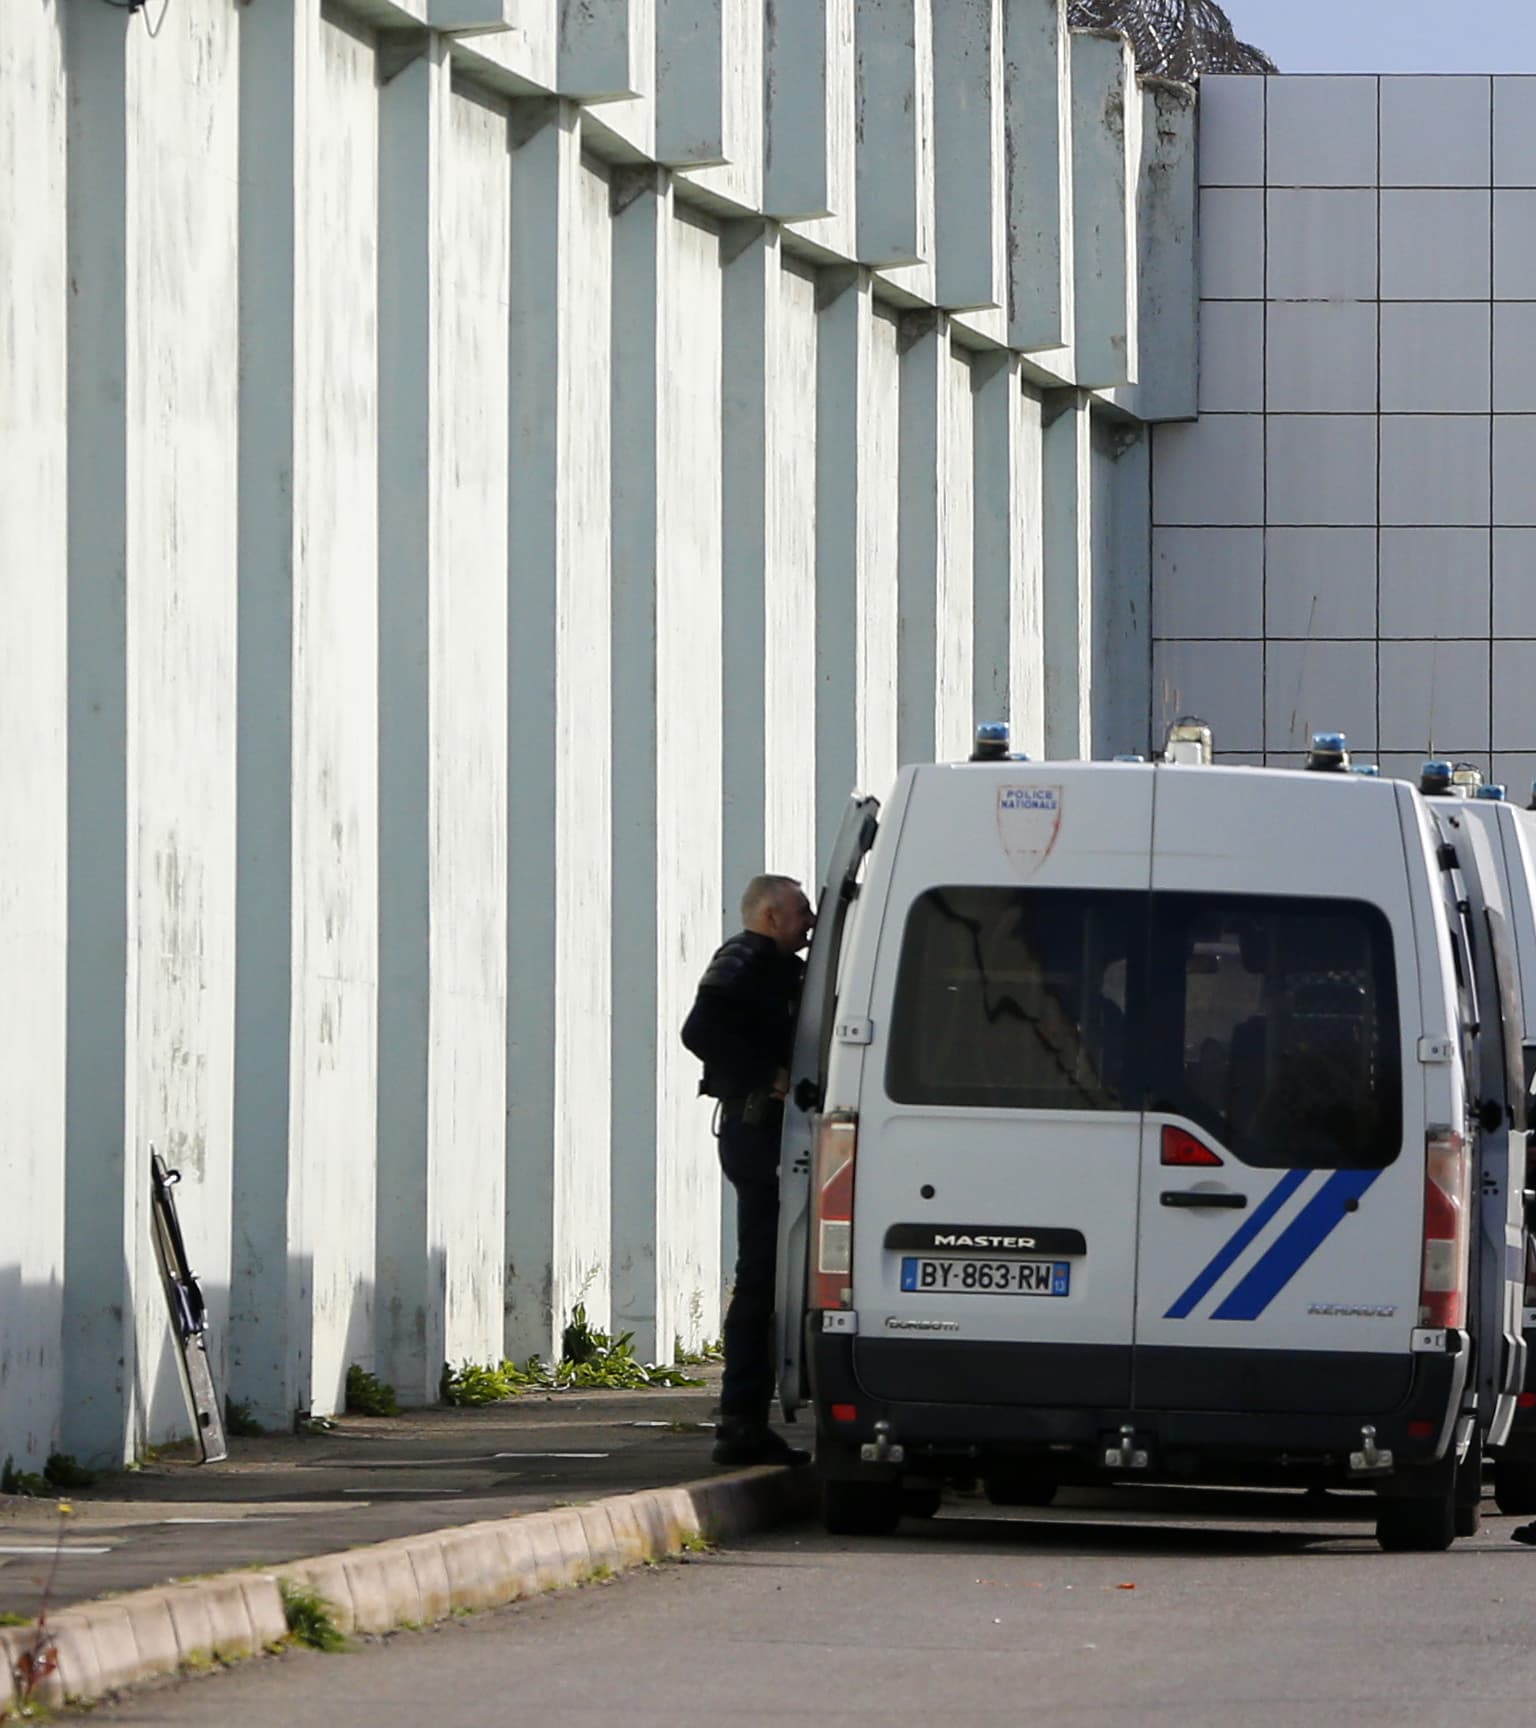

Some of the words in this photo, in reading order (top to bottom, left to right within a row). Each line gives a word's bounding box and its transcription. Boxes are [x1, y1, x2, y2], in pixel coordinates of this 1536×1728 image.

[1006, 790, 1054, 799] POLICE
[1000, 800, 1057, 809] NATIONALE
[934, 1234, 1037, 1249] MASTER
[920, 1262, 1051, 1290] BY-863-RW
